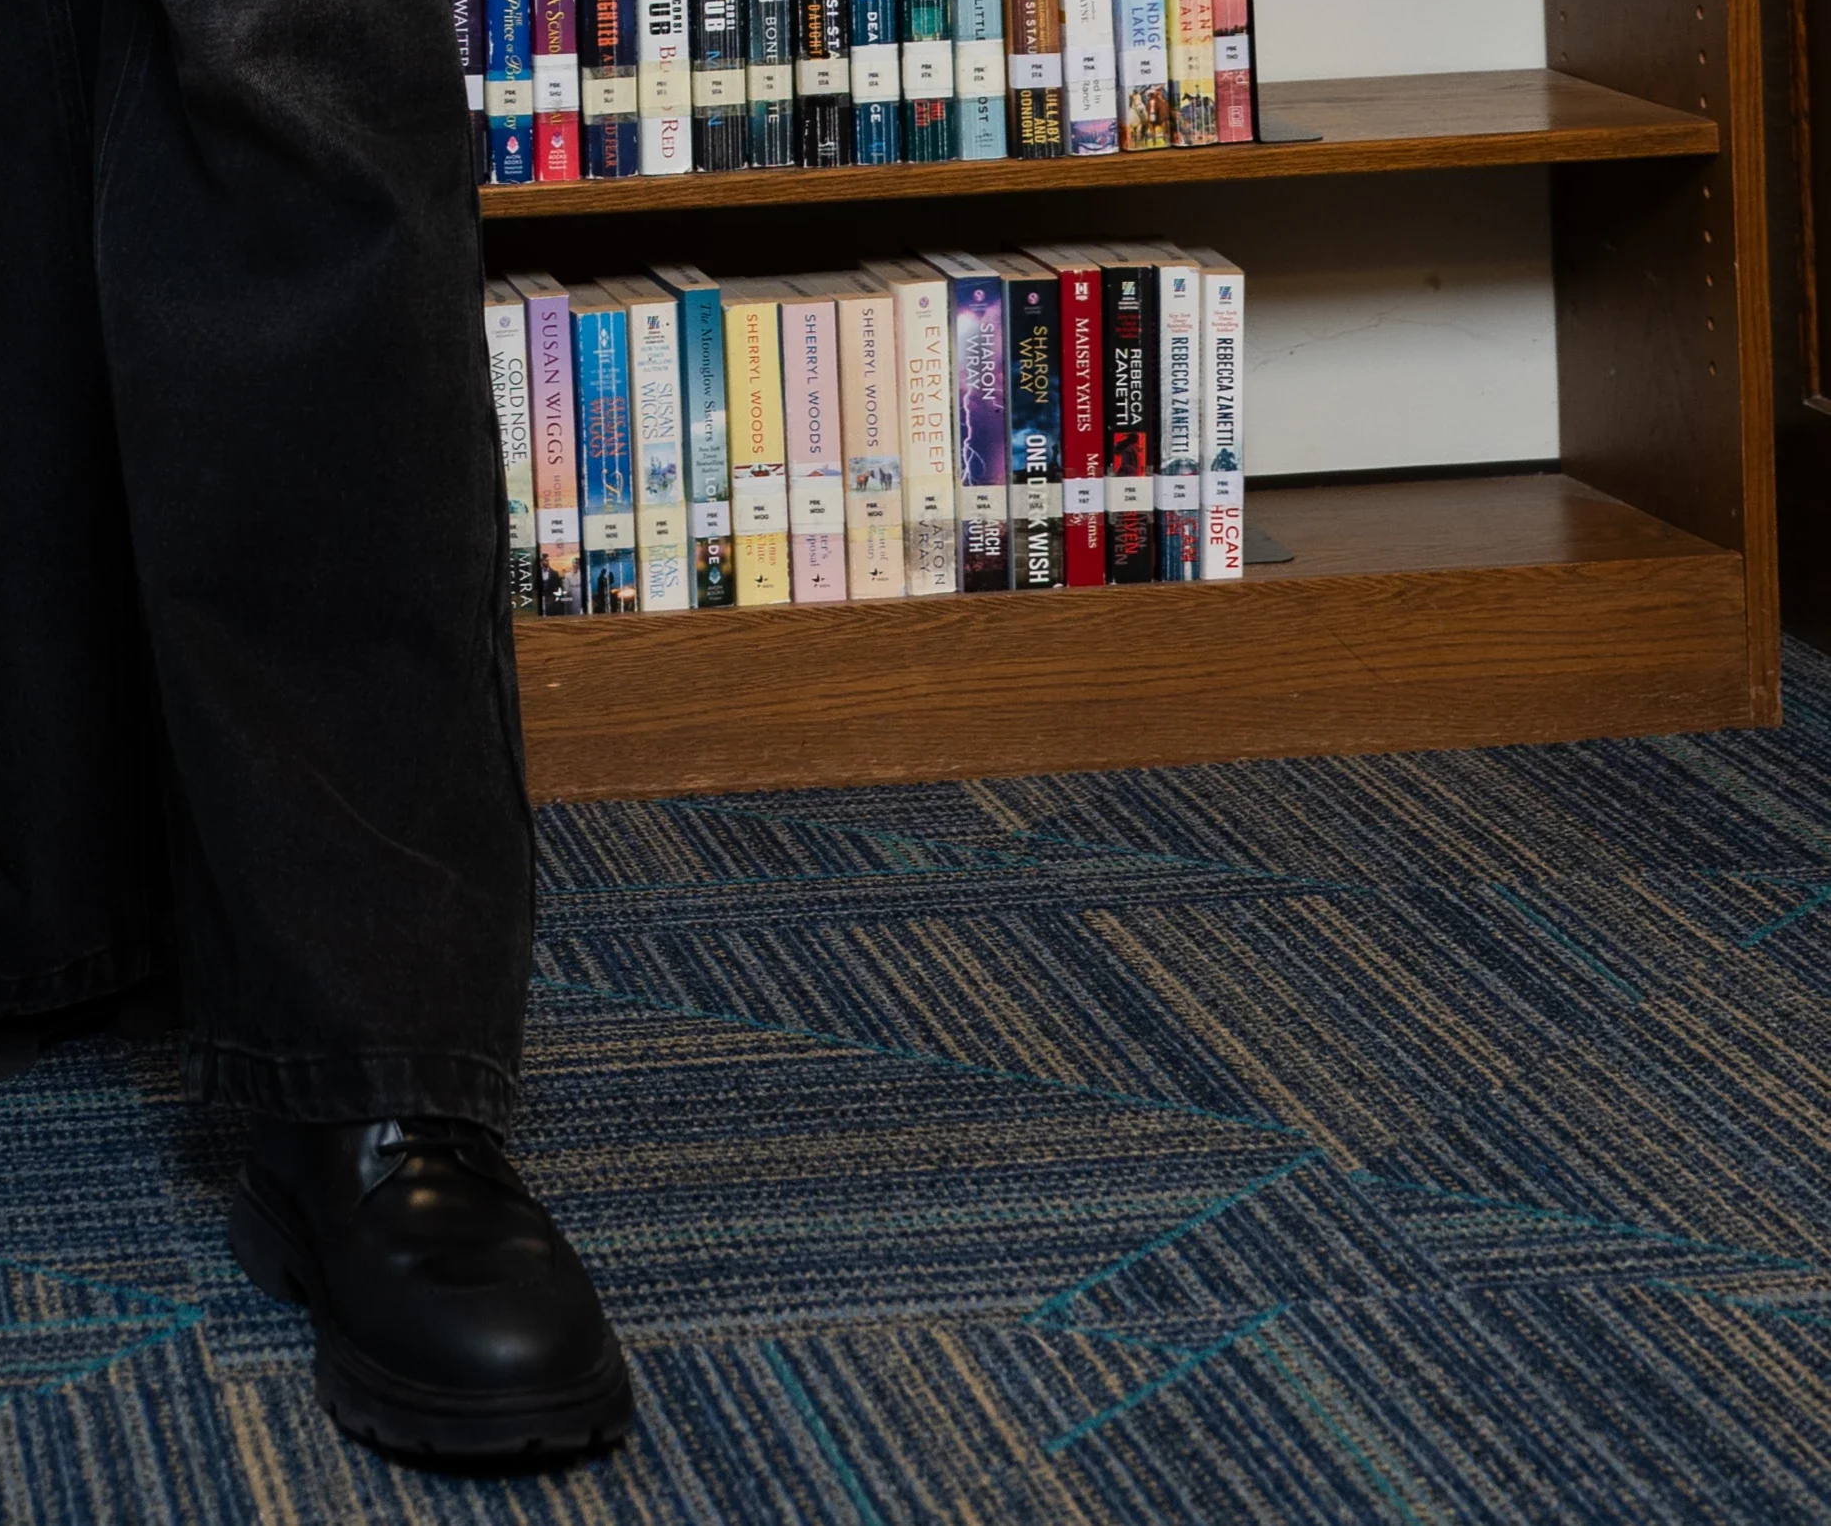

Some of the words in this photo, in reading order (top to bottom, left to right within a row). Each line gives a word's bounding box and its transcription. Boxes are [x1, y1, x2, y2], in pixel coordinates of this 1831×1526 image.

[673, 0, 682, 34] CORSI
[1020, 339, 1032, 391] WRAY
[1034, 327, 1048, 402] SHARON
[1116, 349, 1128, 425] ZANETTI
[1131, 349, 1142, 424] REBECCA
[809, 392, 820, 453] WOODS
[866, 386, 877, 446] WOODS
